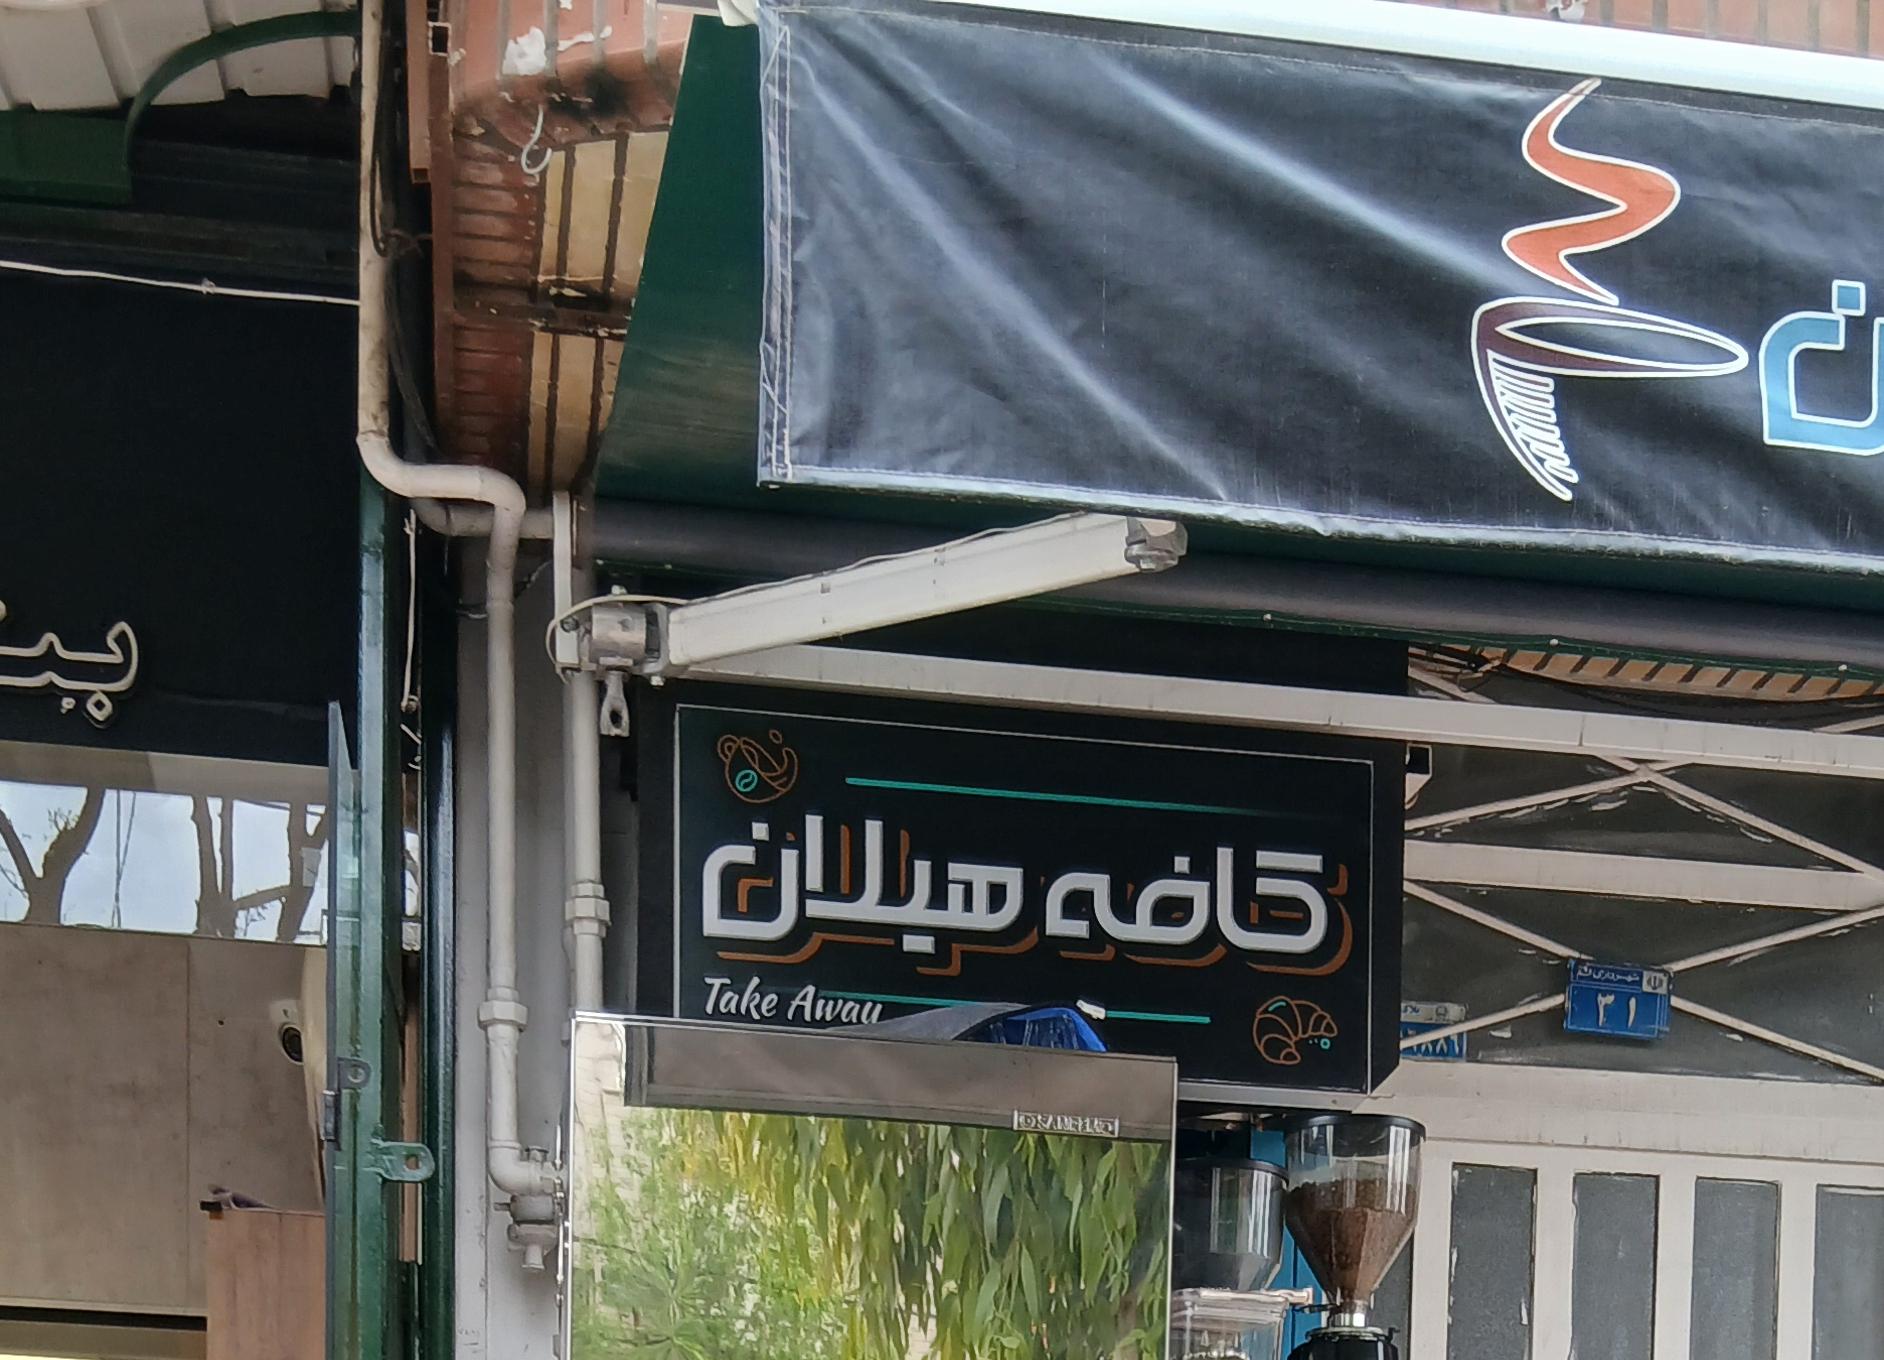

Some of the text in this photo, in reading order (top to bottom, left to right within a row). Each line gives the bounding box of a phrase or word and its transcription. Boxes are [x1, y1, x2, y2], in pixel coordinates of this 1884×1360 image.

[702, 813, 1330, 956] کافه هیلان
[704, 975, 883, 1024] Take Away
